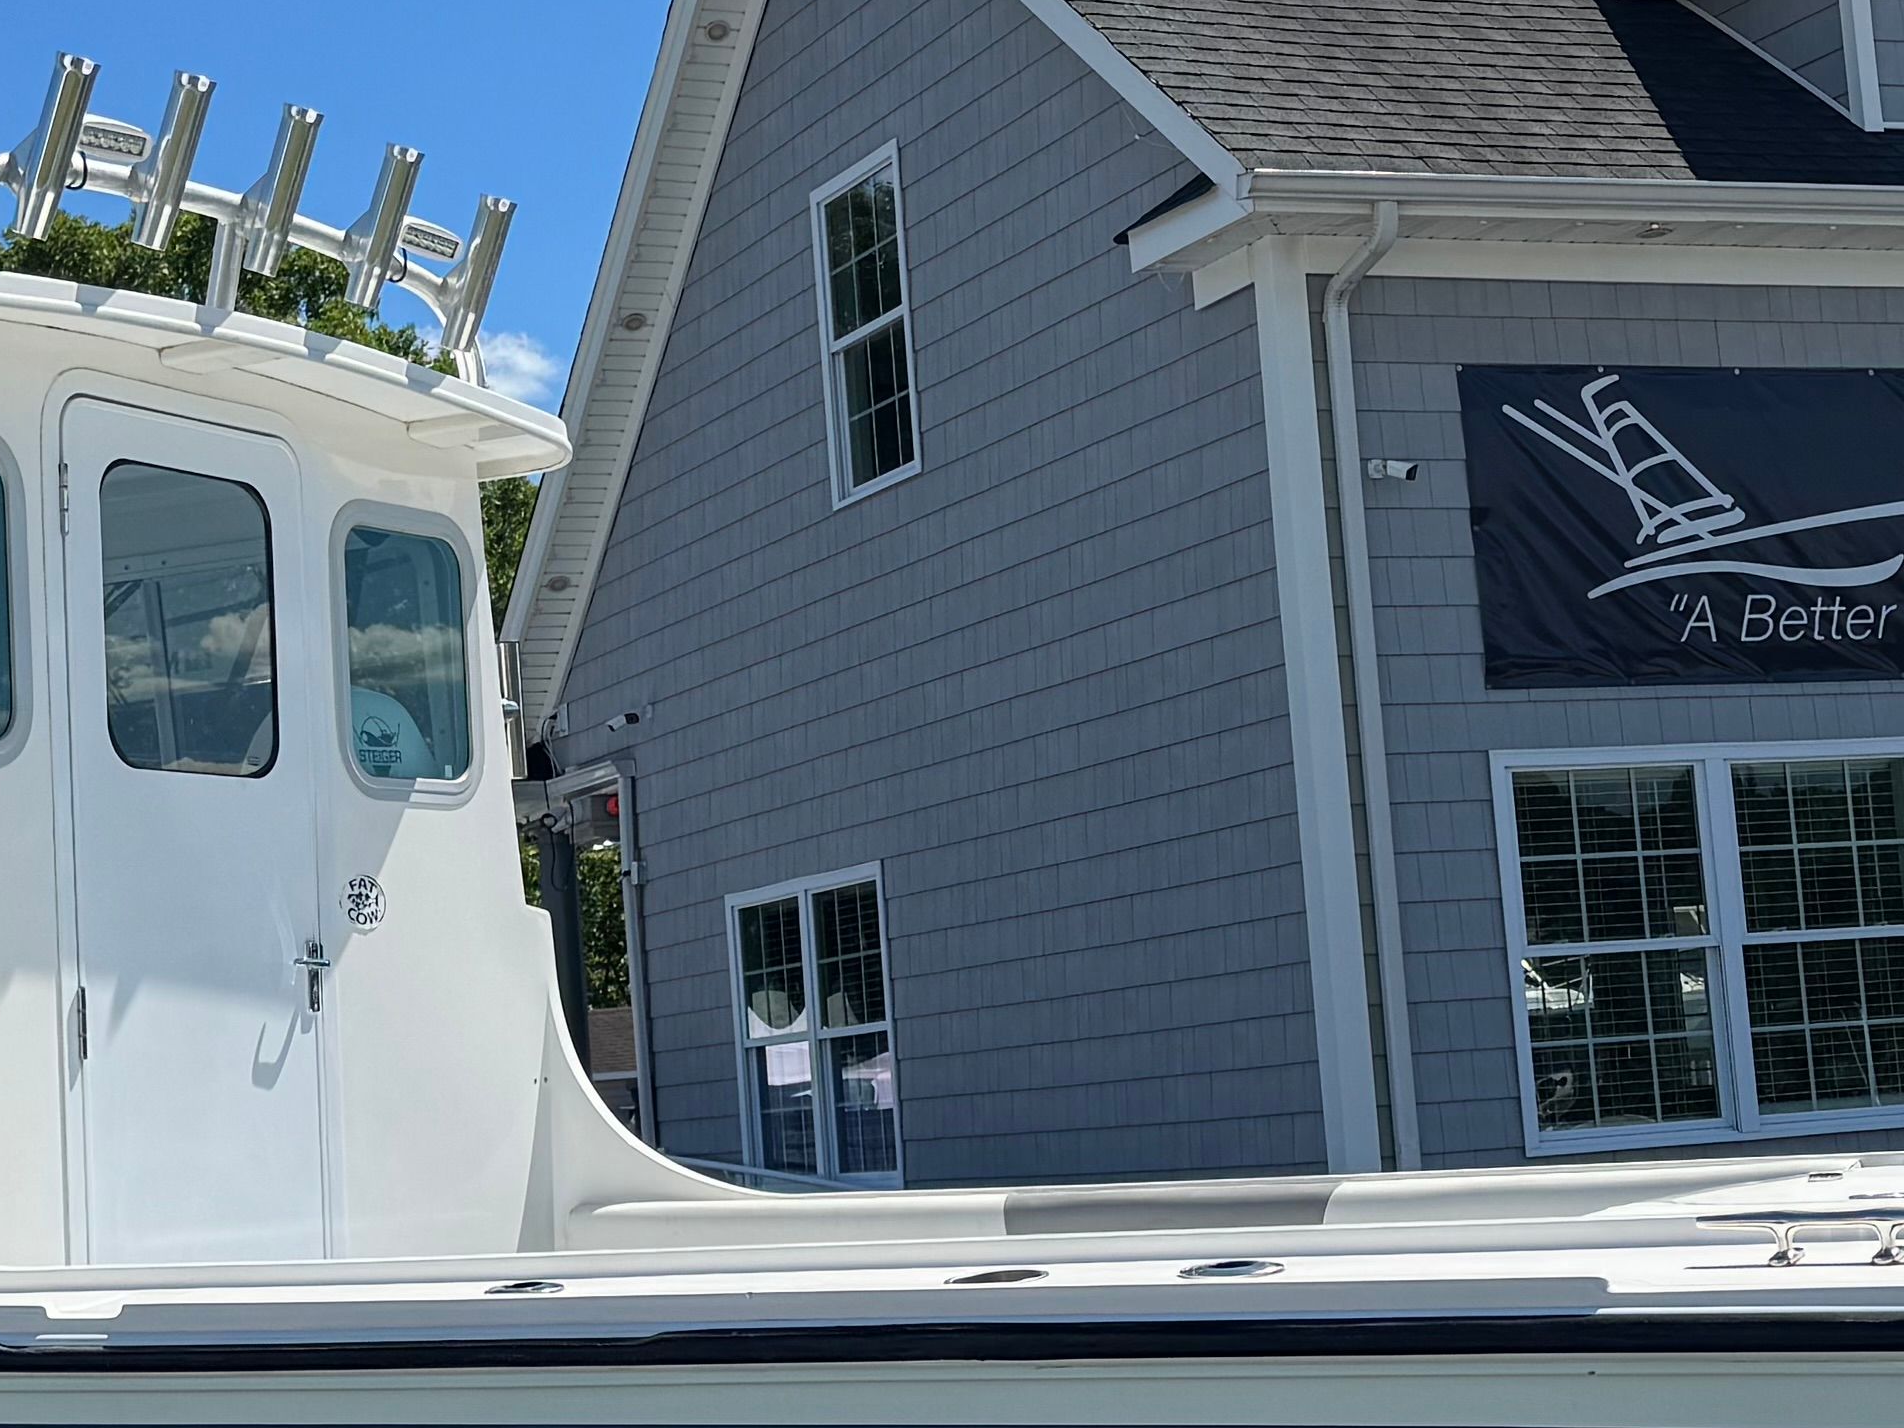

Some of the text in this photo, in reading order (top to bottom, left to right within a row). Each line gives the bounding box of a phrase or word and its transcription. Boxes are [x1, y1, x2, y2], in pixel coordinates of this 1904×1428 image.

[1740, 594, 1897, 643] Better
[358, 748, 403, 765] STEIGER
[348, 878, 378, 893] FAT
[347, 907, 379, 925] COW
